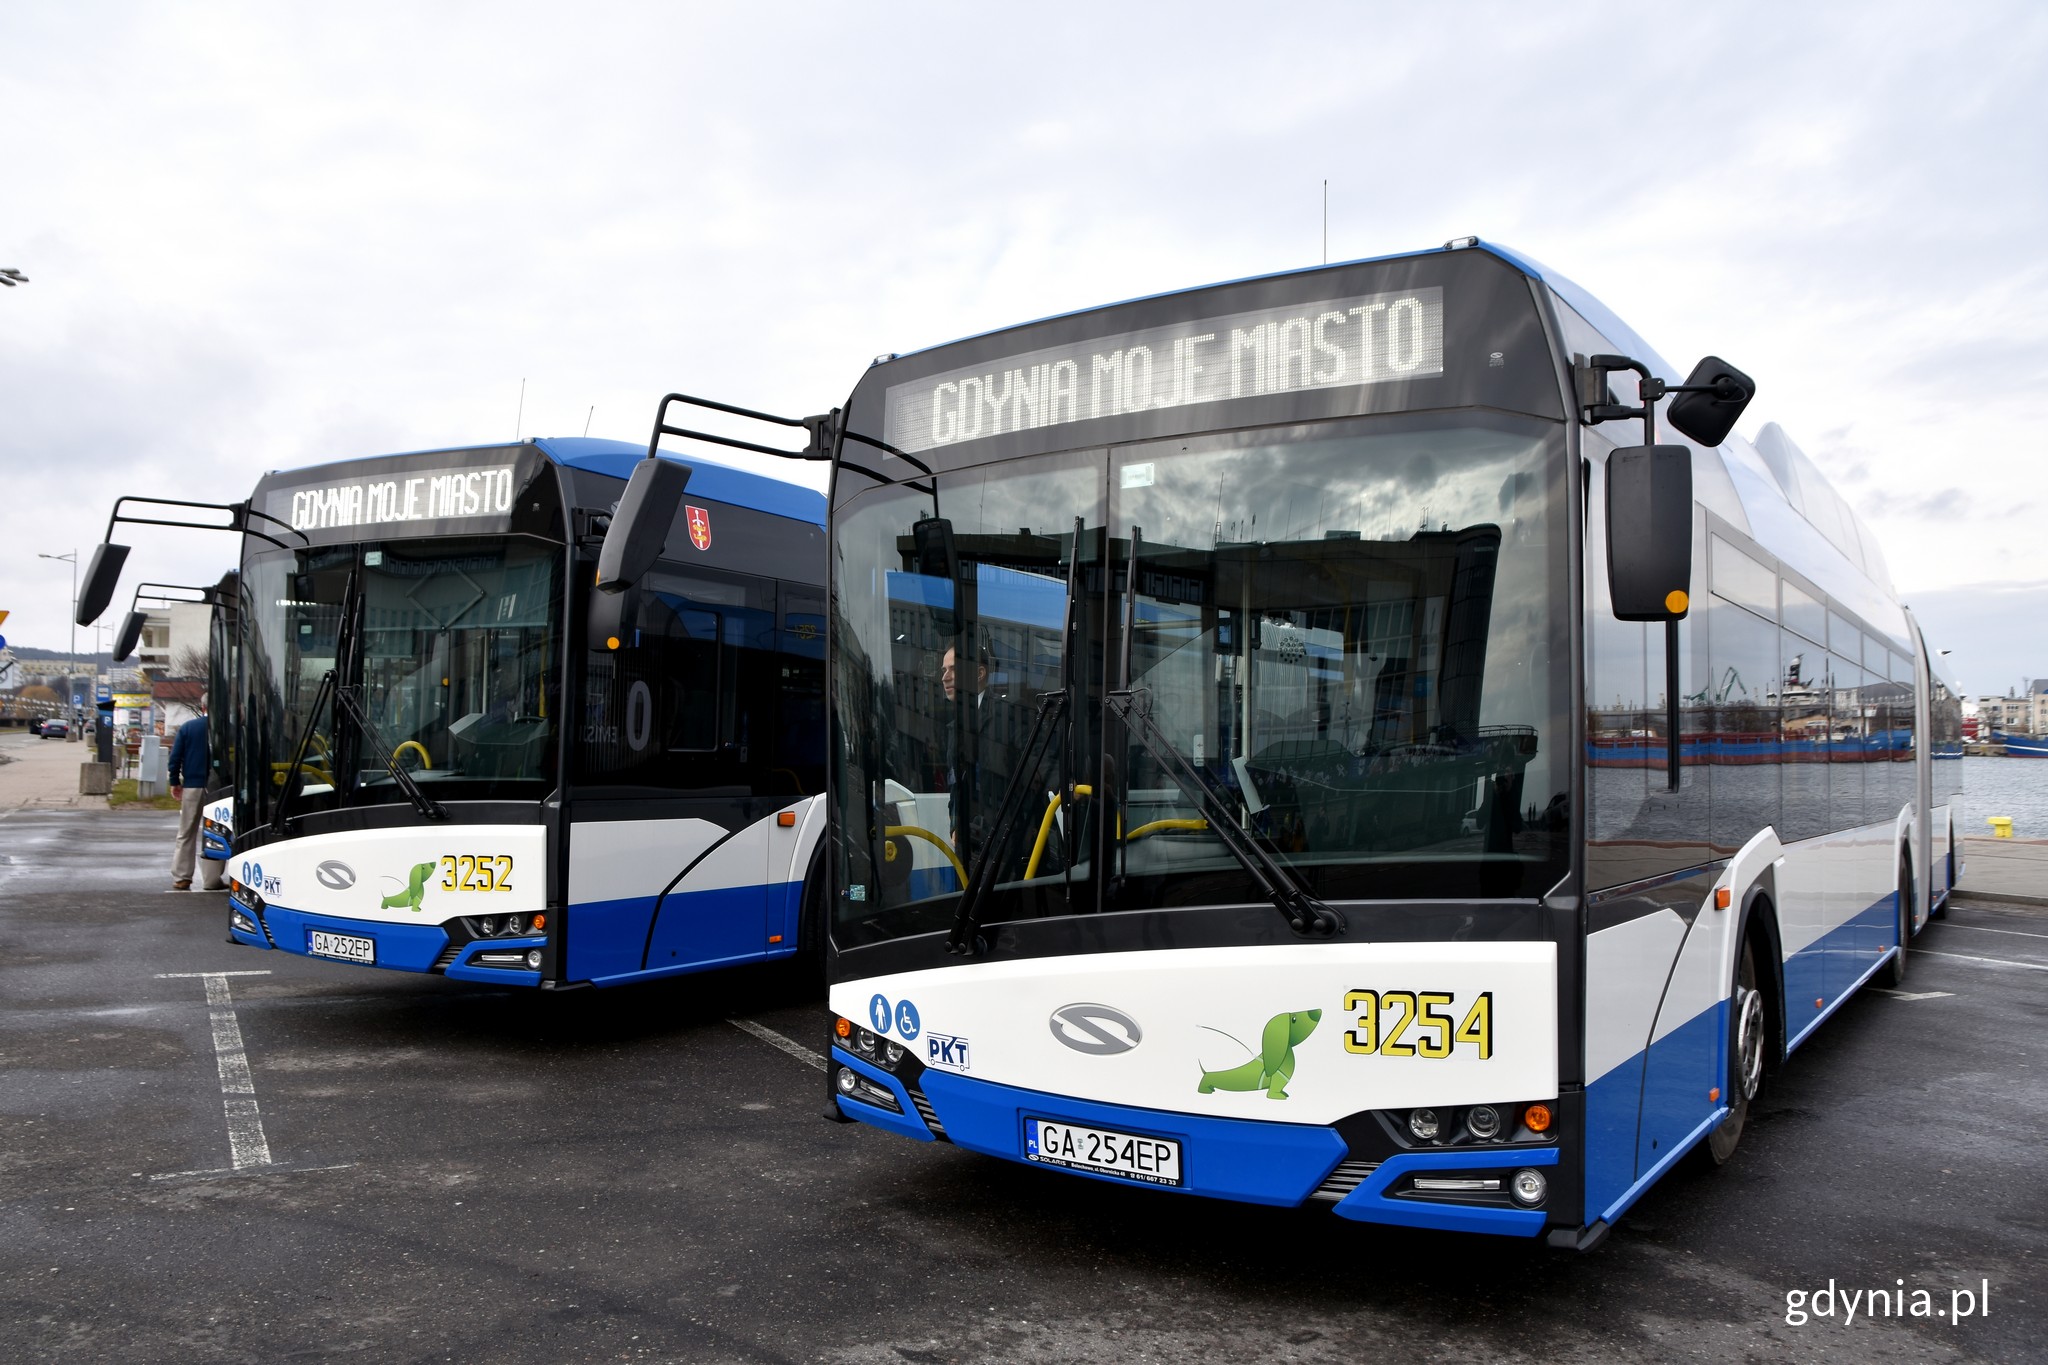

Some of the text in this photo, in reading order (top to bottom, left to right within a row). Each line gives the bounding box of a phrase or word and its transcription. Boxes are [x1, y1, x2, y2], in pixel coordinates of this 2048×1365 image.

[931, 296, 1424, 445] GDYNIA MOJE MIASTO
[291, 468, 512, 530] GDYNIA MOJE MIASTO
[264, 877, 280, 893] PKT
[441, 854, 513, 892] 3252
[314, 933, 371, 958] GA 252EP
[1343, 988, 1493, 1060] 3254
[928, 1036, 967, 1064] PKT
[1028, 1139, 1038, 1149] PL
[1043, 1125, 1171, 1173] GA 254EP
[1039, 1156, 1067, 1166] SOLARIS
